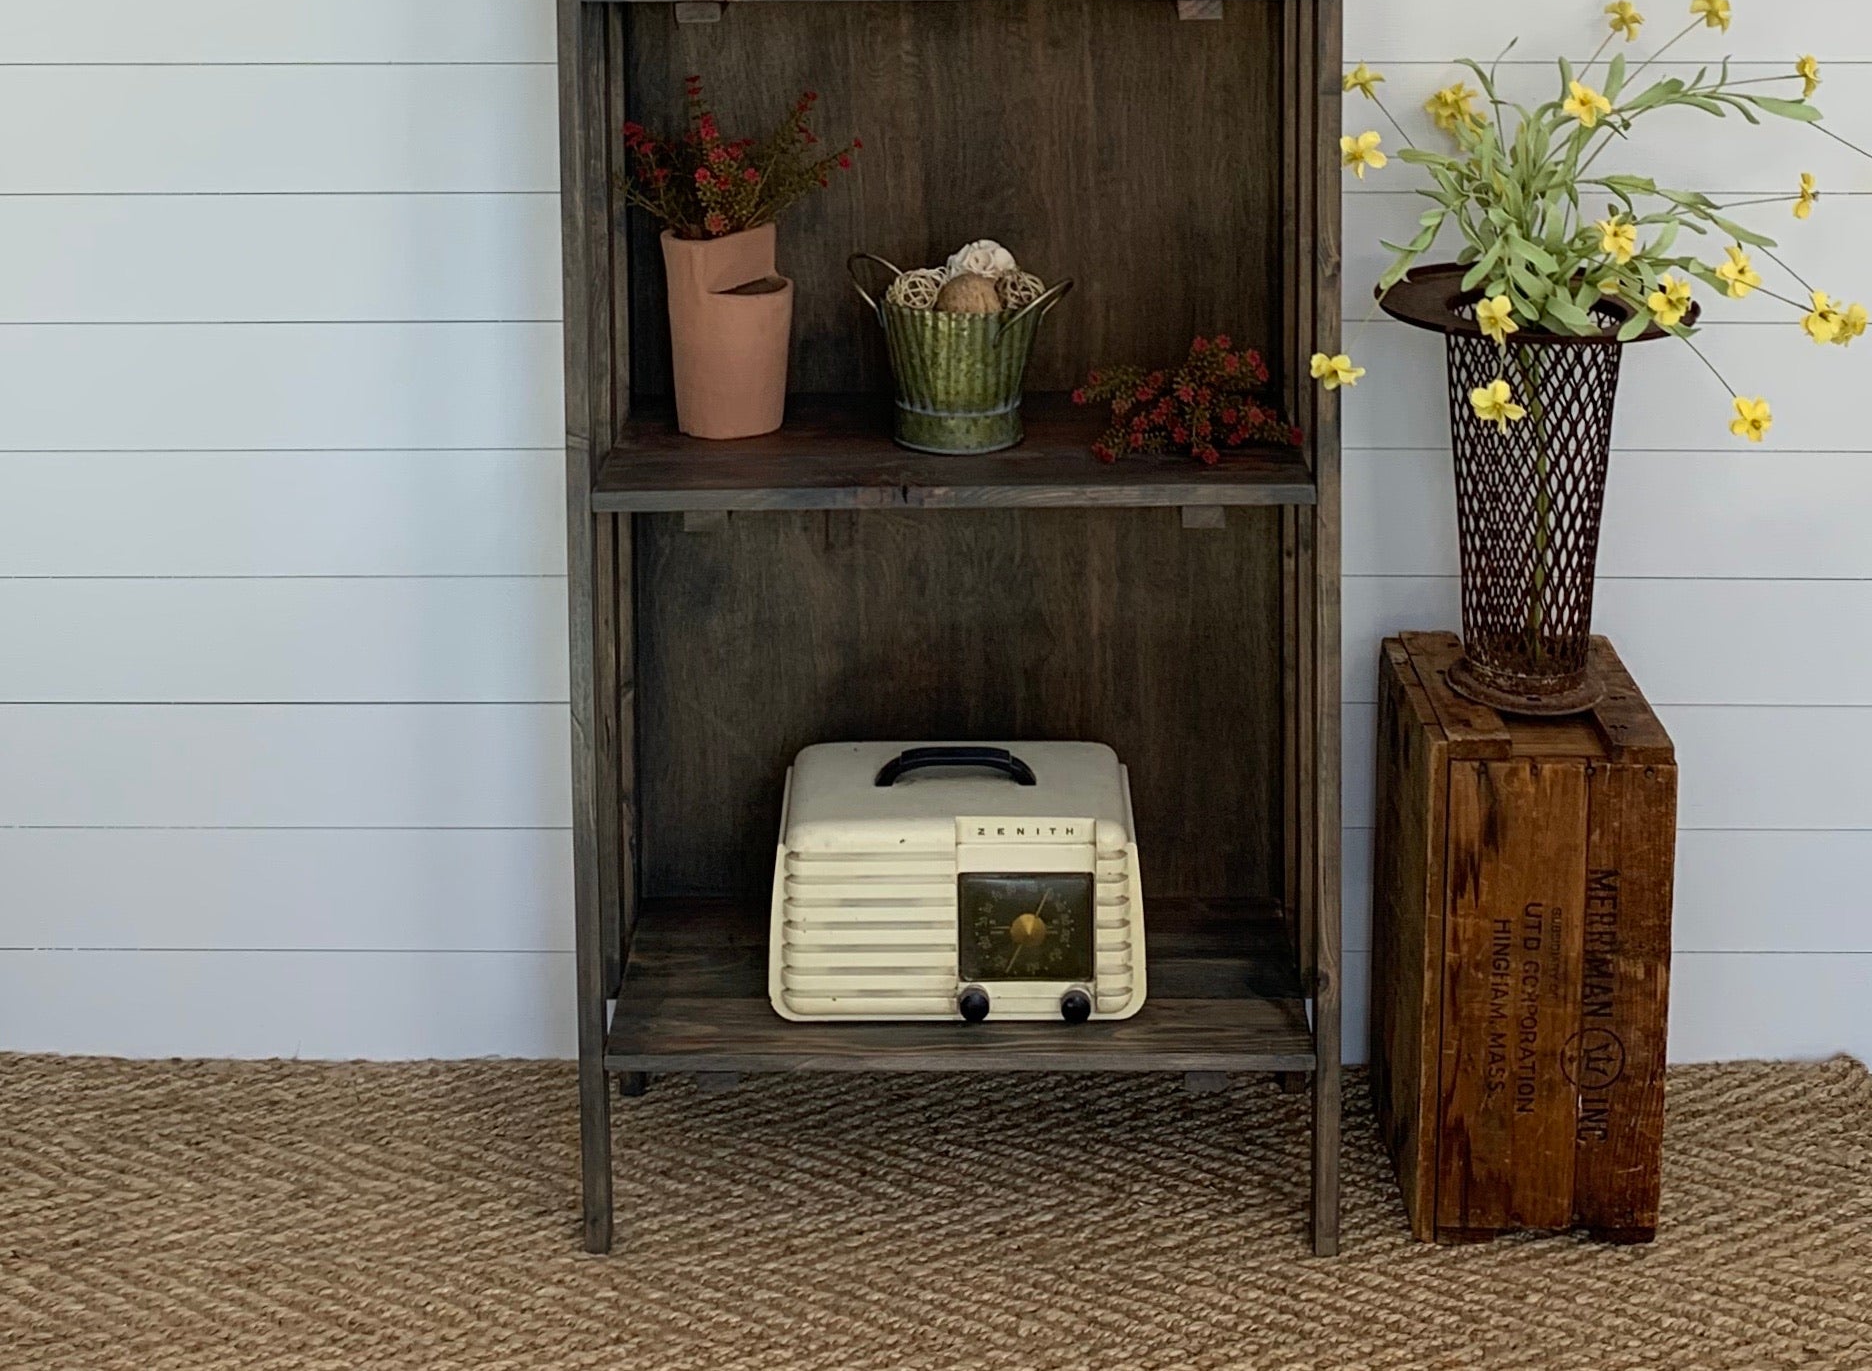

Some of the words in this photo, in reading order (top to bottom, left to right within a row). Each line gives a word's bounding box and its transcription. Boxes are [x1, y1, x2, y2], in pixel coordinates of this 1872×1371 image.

[977, 826, 1075, 836] ZENITH
[1523, 902, 1543, 951] UTD
[1581, 868, 1621, 1018] MERRIMAN
[1486, 1032, 1508, 1099] MASS.
[1516, 960, 1541, 1114] CORPORATION
